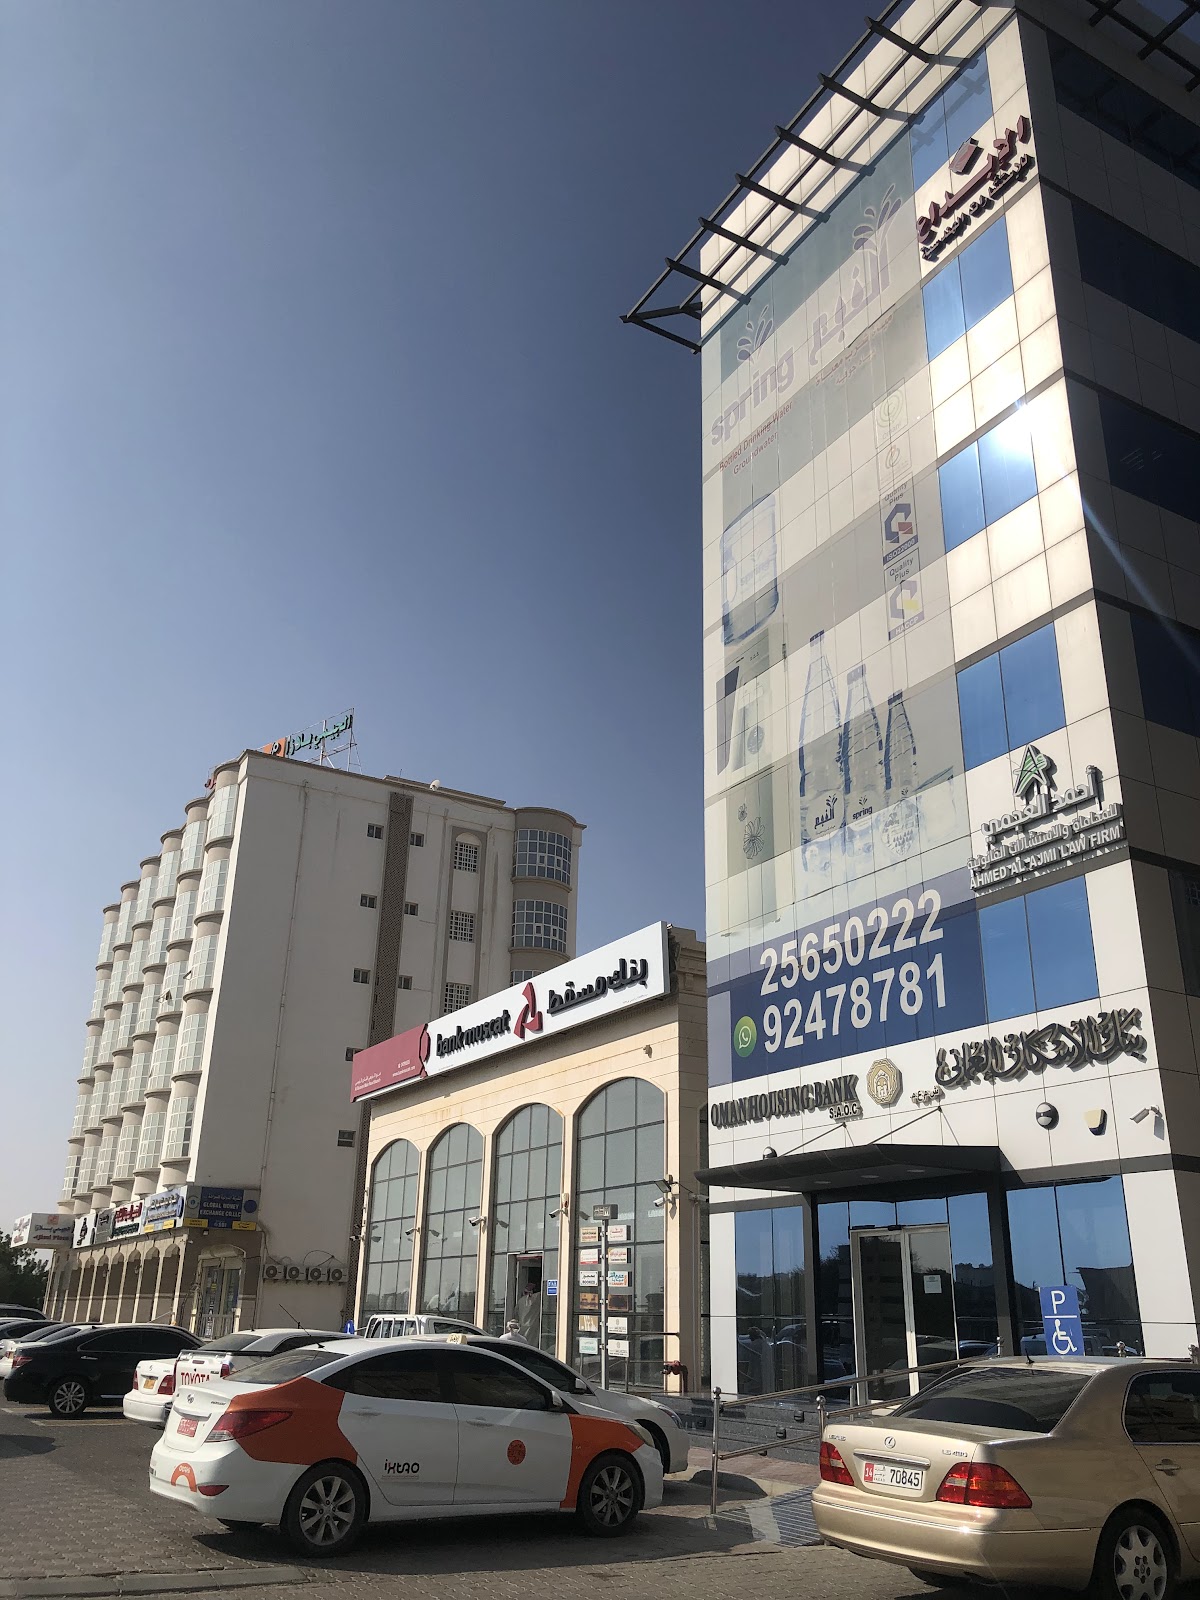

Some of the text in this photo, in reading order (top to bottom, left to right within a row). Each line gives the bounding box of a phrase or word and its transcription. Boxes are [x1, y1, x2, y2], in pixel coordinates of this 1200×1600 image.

[711, 346, 795, 445] spring
[719, 401, 793, 472] Bottled Drinking Water
[733, 432, 778, 475] Groundwater
[884, 482, 908, 501] Quality
[889, 557, 914, 577] Quality
[894, 568, 910, 582] Plus
[895, 616, 919, 635] HACCP
[852, 806, 873, 820] spring
[969, 825, 1121, 890] AHMED AL AJMI LAW FIRM
[759, 889, 944, 997] 25650222
[763, 952, 947, 1053] 92478781
[710, 1074, 859, 1127] OMAN HOUSING BANK
[1050, 1290, 1066, 1314] P
[864, 1466, 873, 1477] 14
[890, 1469, 920, 1487] 70845
